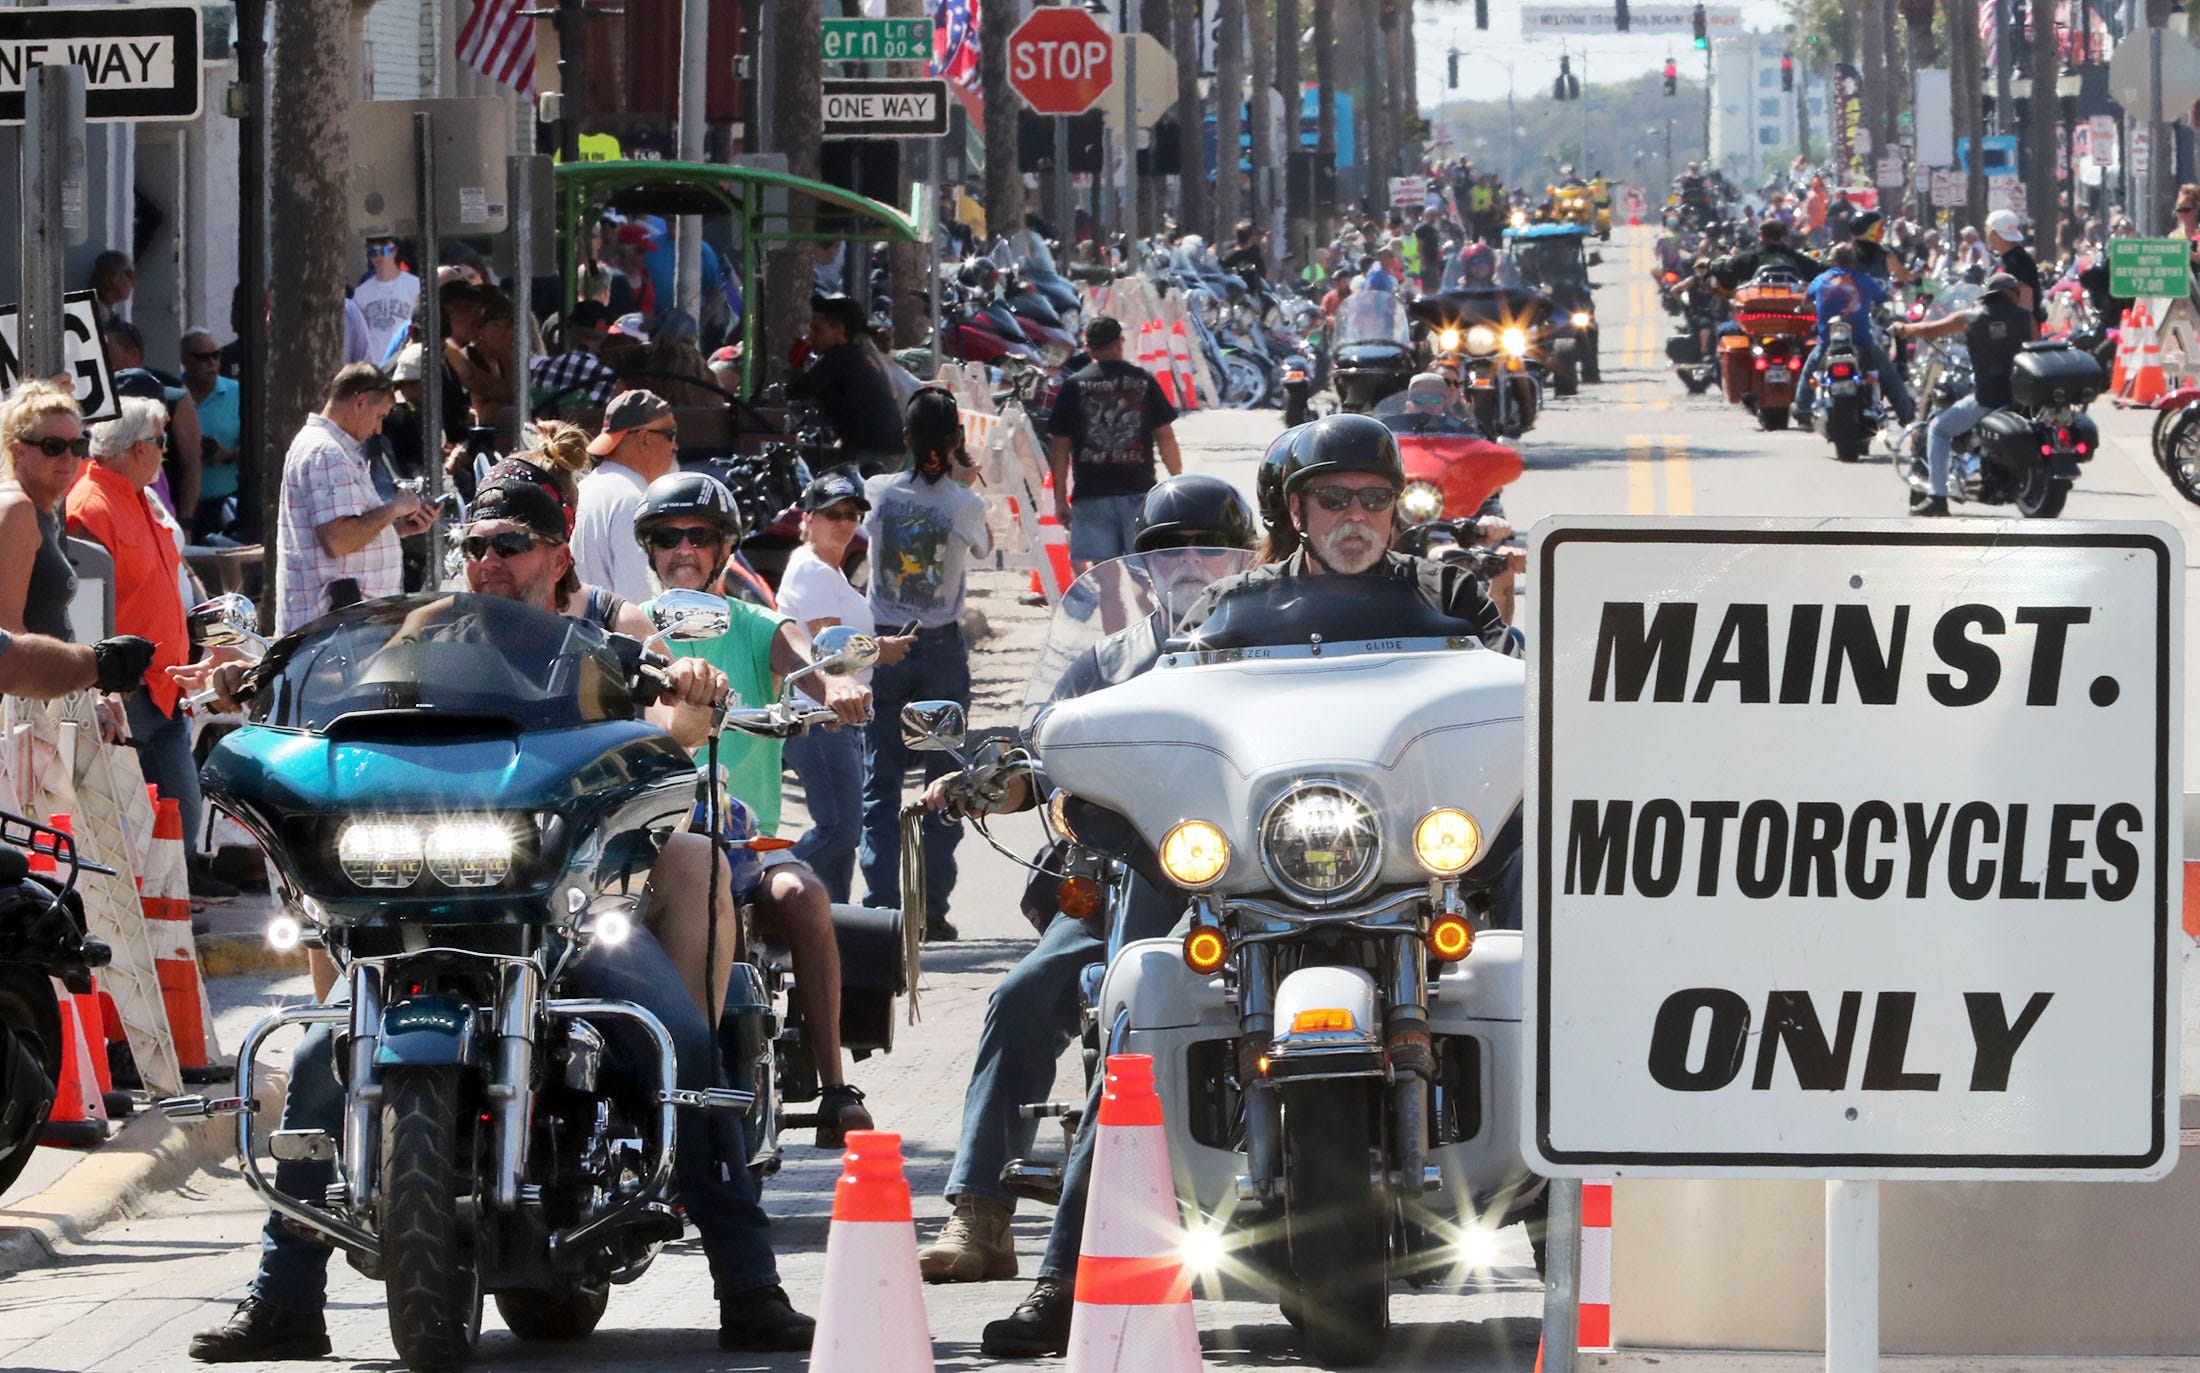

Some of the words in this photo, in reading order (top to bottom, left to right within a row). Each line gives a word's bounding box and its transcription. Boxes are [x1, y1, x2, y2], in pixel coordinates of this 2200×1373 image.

[822, 25, 878, 57] ern
[884, 22, 906, 39] Ln
[1015, 40, 1107, 80] STOP
[67, 42, 161, 84] WAY
[828, 97, 873, 118] ONE
[882, 97, 928, 117] WAY
[1366, 641, 1403, 651] GLIDE
[1589, 602, 1910, 705] MAIN
[1926, 603, 2120, 707] ST.
[1564, 798, 2143, 901] MOTORCYCLES
[1648, 987, 2055, 1092] ONLY
